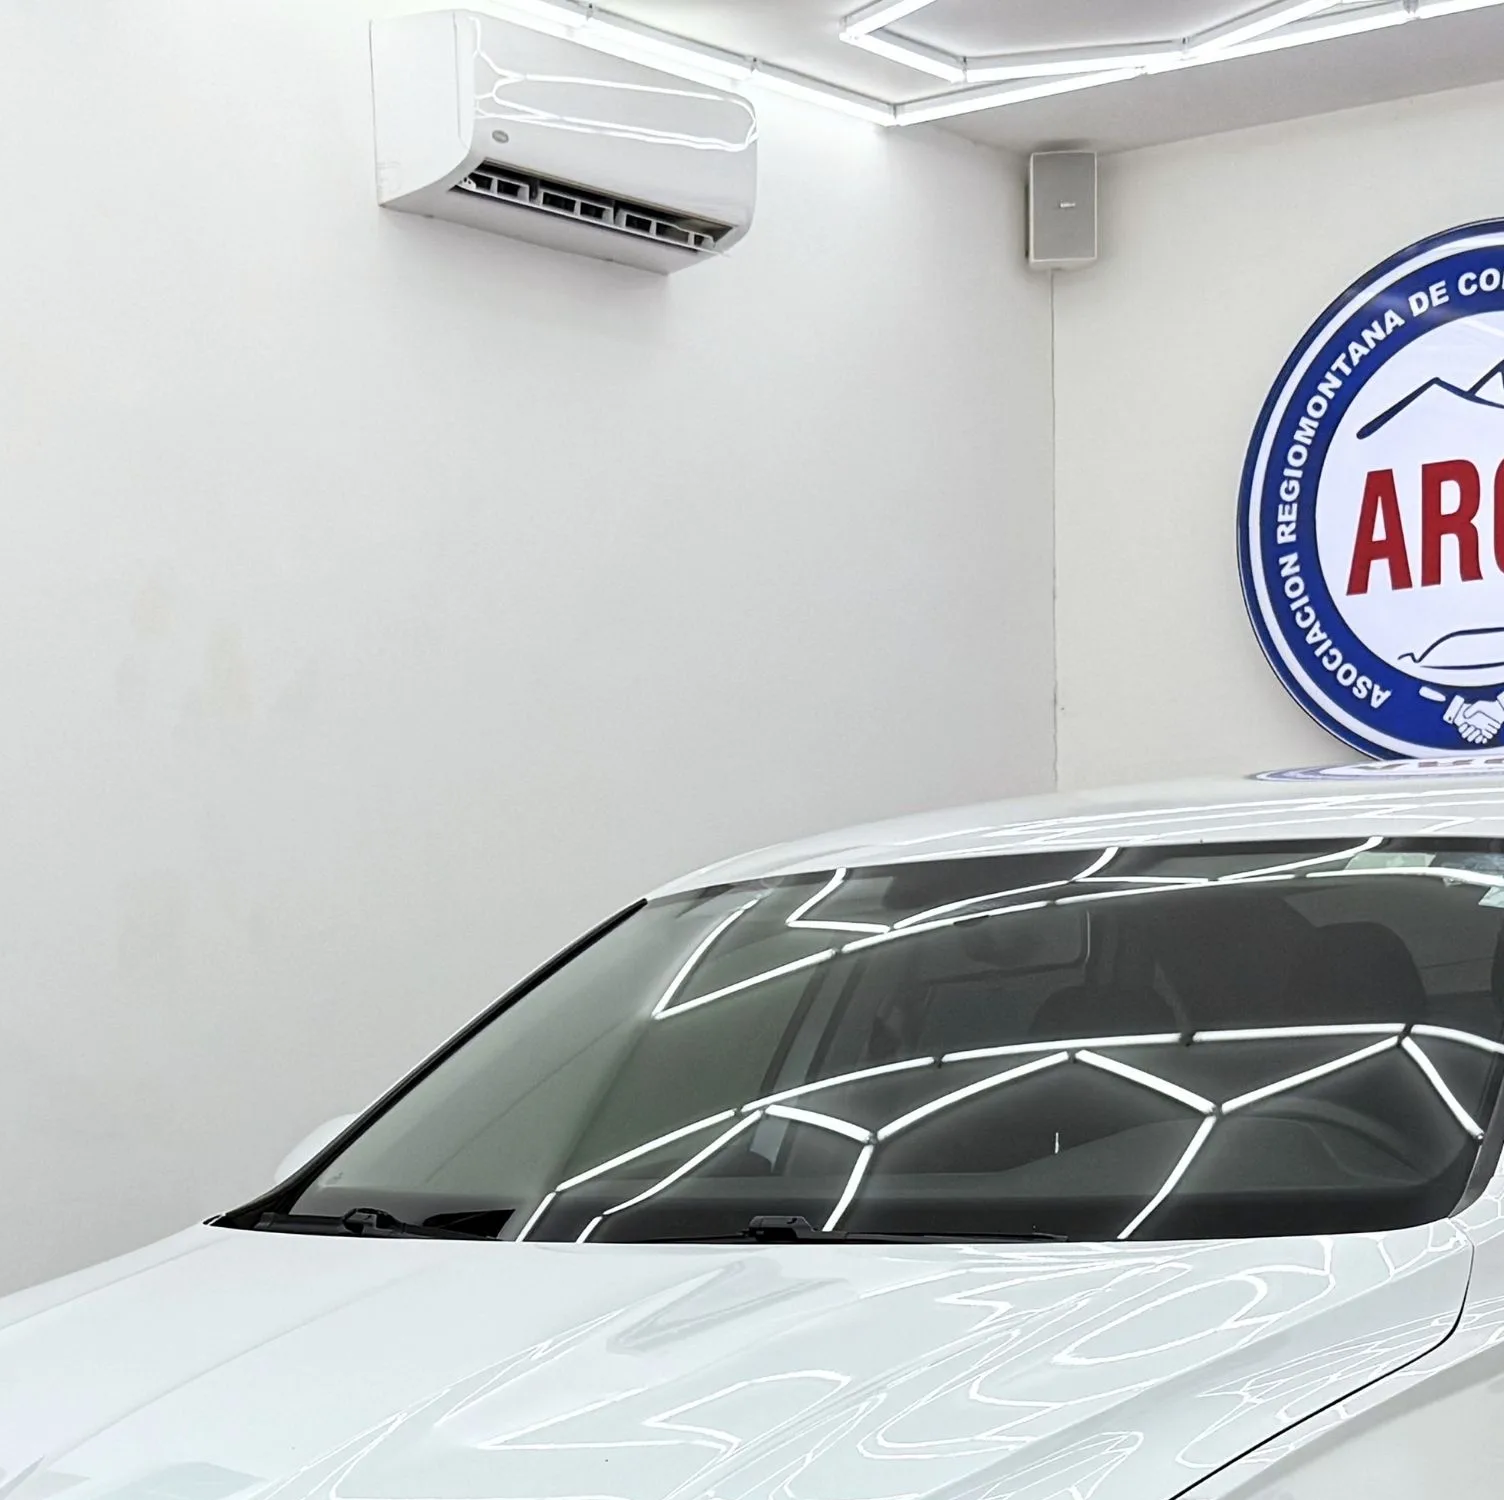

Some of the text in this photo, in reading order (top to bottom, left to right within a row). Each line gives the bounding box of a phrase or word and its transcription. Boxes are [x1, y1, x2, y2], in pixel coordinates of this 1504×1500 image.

[1407, 280, 1450, 318] DE
[1276, 308, 1406, 545] REGIOMONTANA
[1278, 552, 1392, 709] ASOCIACION
